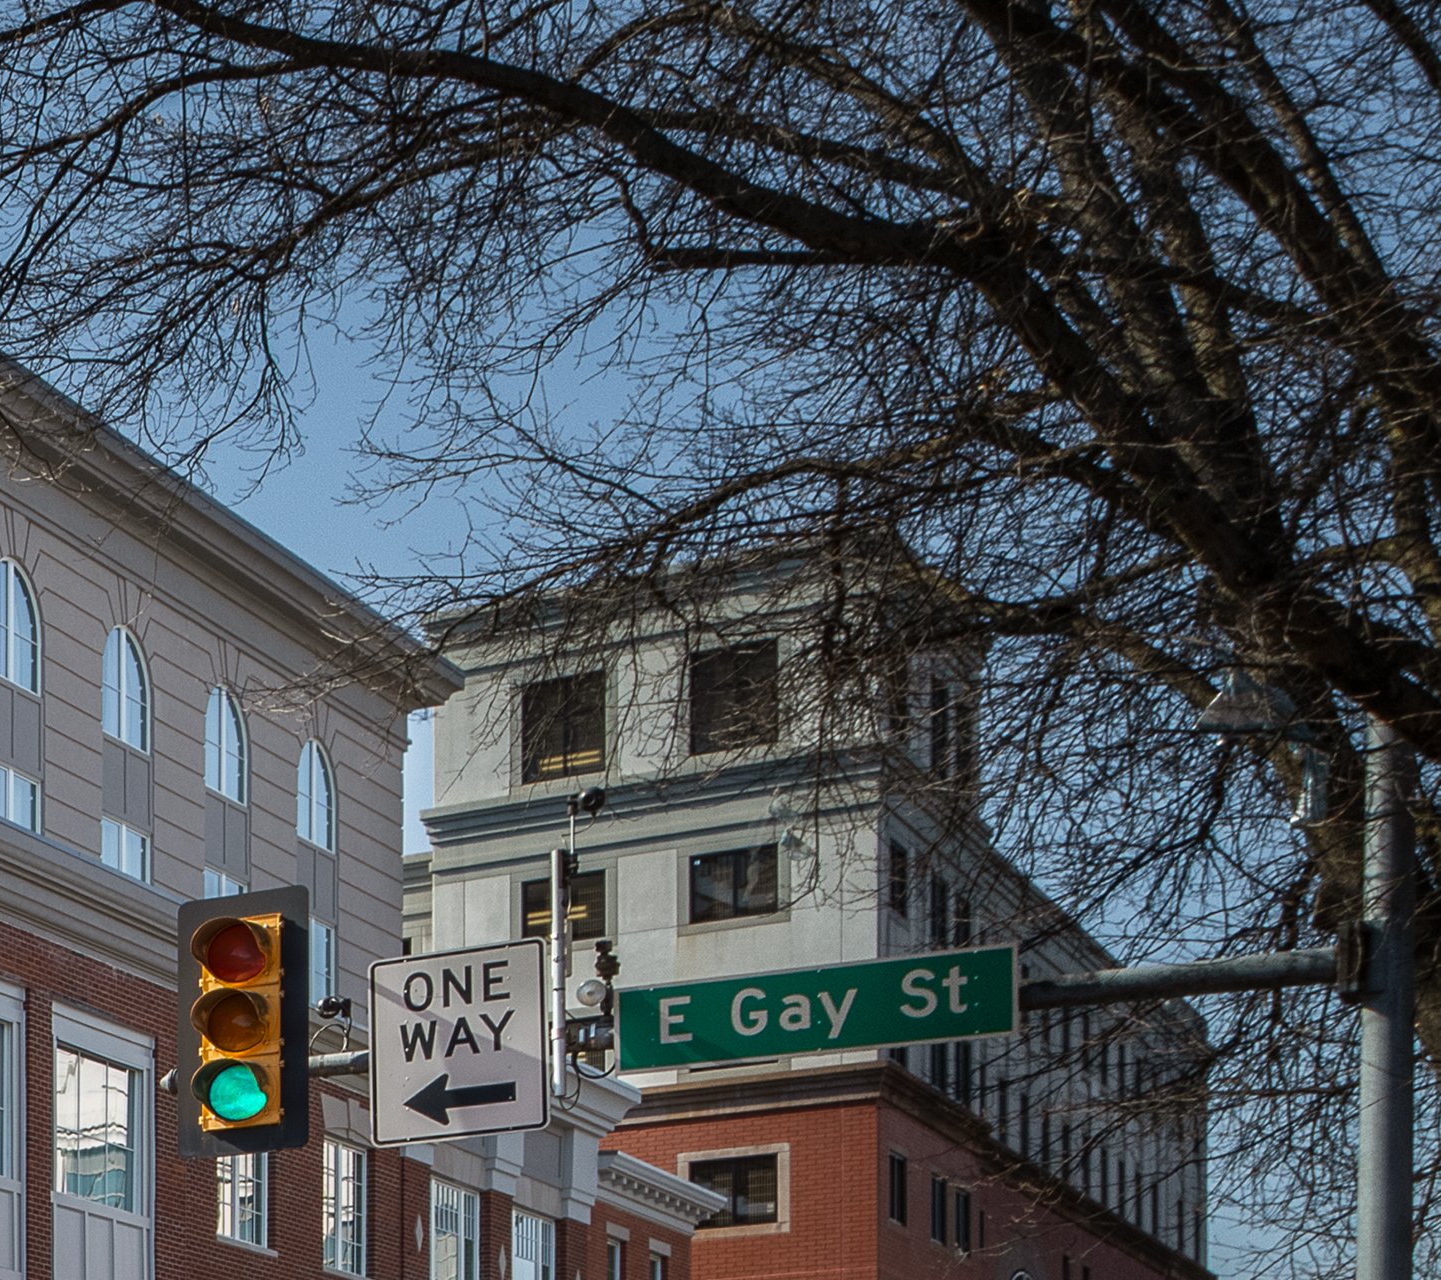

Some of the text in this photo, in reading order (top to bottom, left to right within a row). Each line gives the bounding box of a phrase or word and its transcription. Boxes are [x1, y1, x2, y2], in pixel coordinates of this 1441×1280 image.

[403, 959, 511, 1012] ONE
[658, 965, 969, 1045] E Gay St
[399, 1009, 515, 1063] WAY
